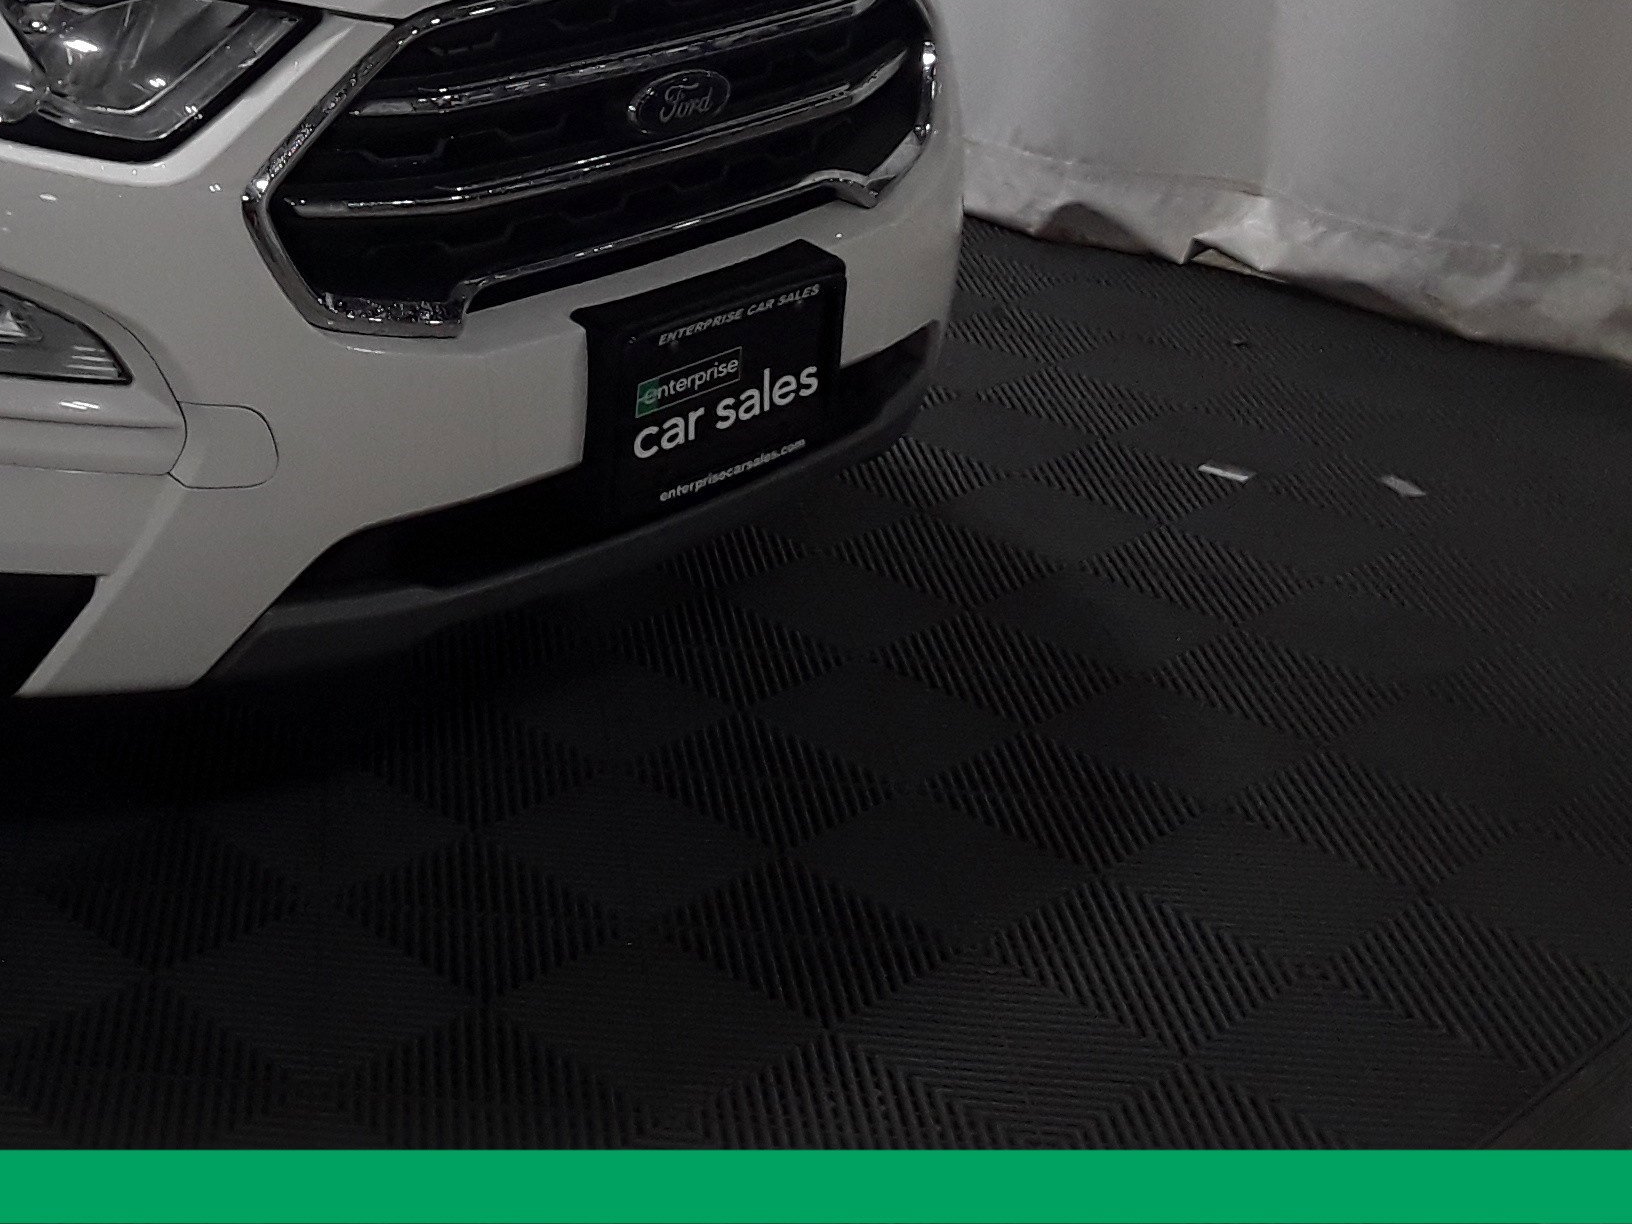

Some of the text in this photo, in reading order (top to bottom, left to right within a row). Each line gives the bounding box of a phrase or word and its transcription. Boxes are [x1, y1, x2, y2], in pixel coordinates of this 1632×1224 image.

[659, 82, 714, 123] Ford
[658, 283, 820, 346] ENTERPRISE CAR SALES
[633, 366, 819, 459] car sales
[643, 359, 739, 405] enterprise
[659, 438, 806, 502] enterprisecarsales.com
